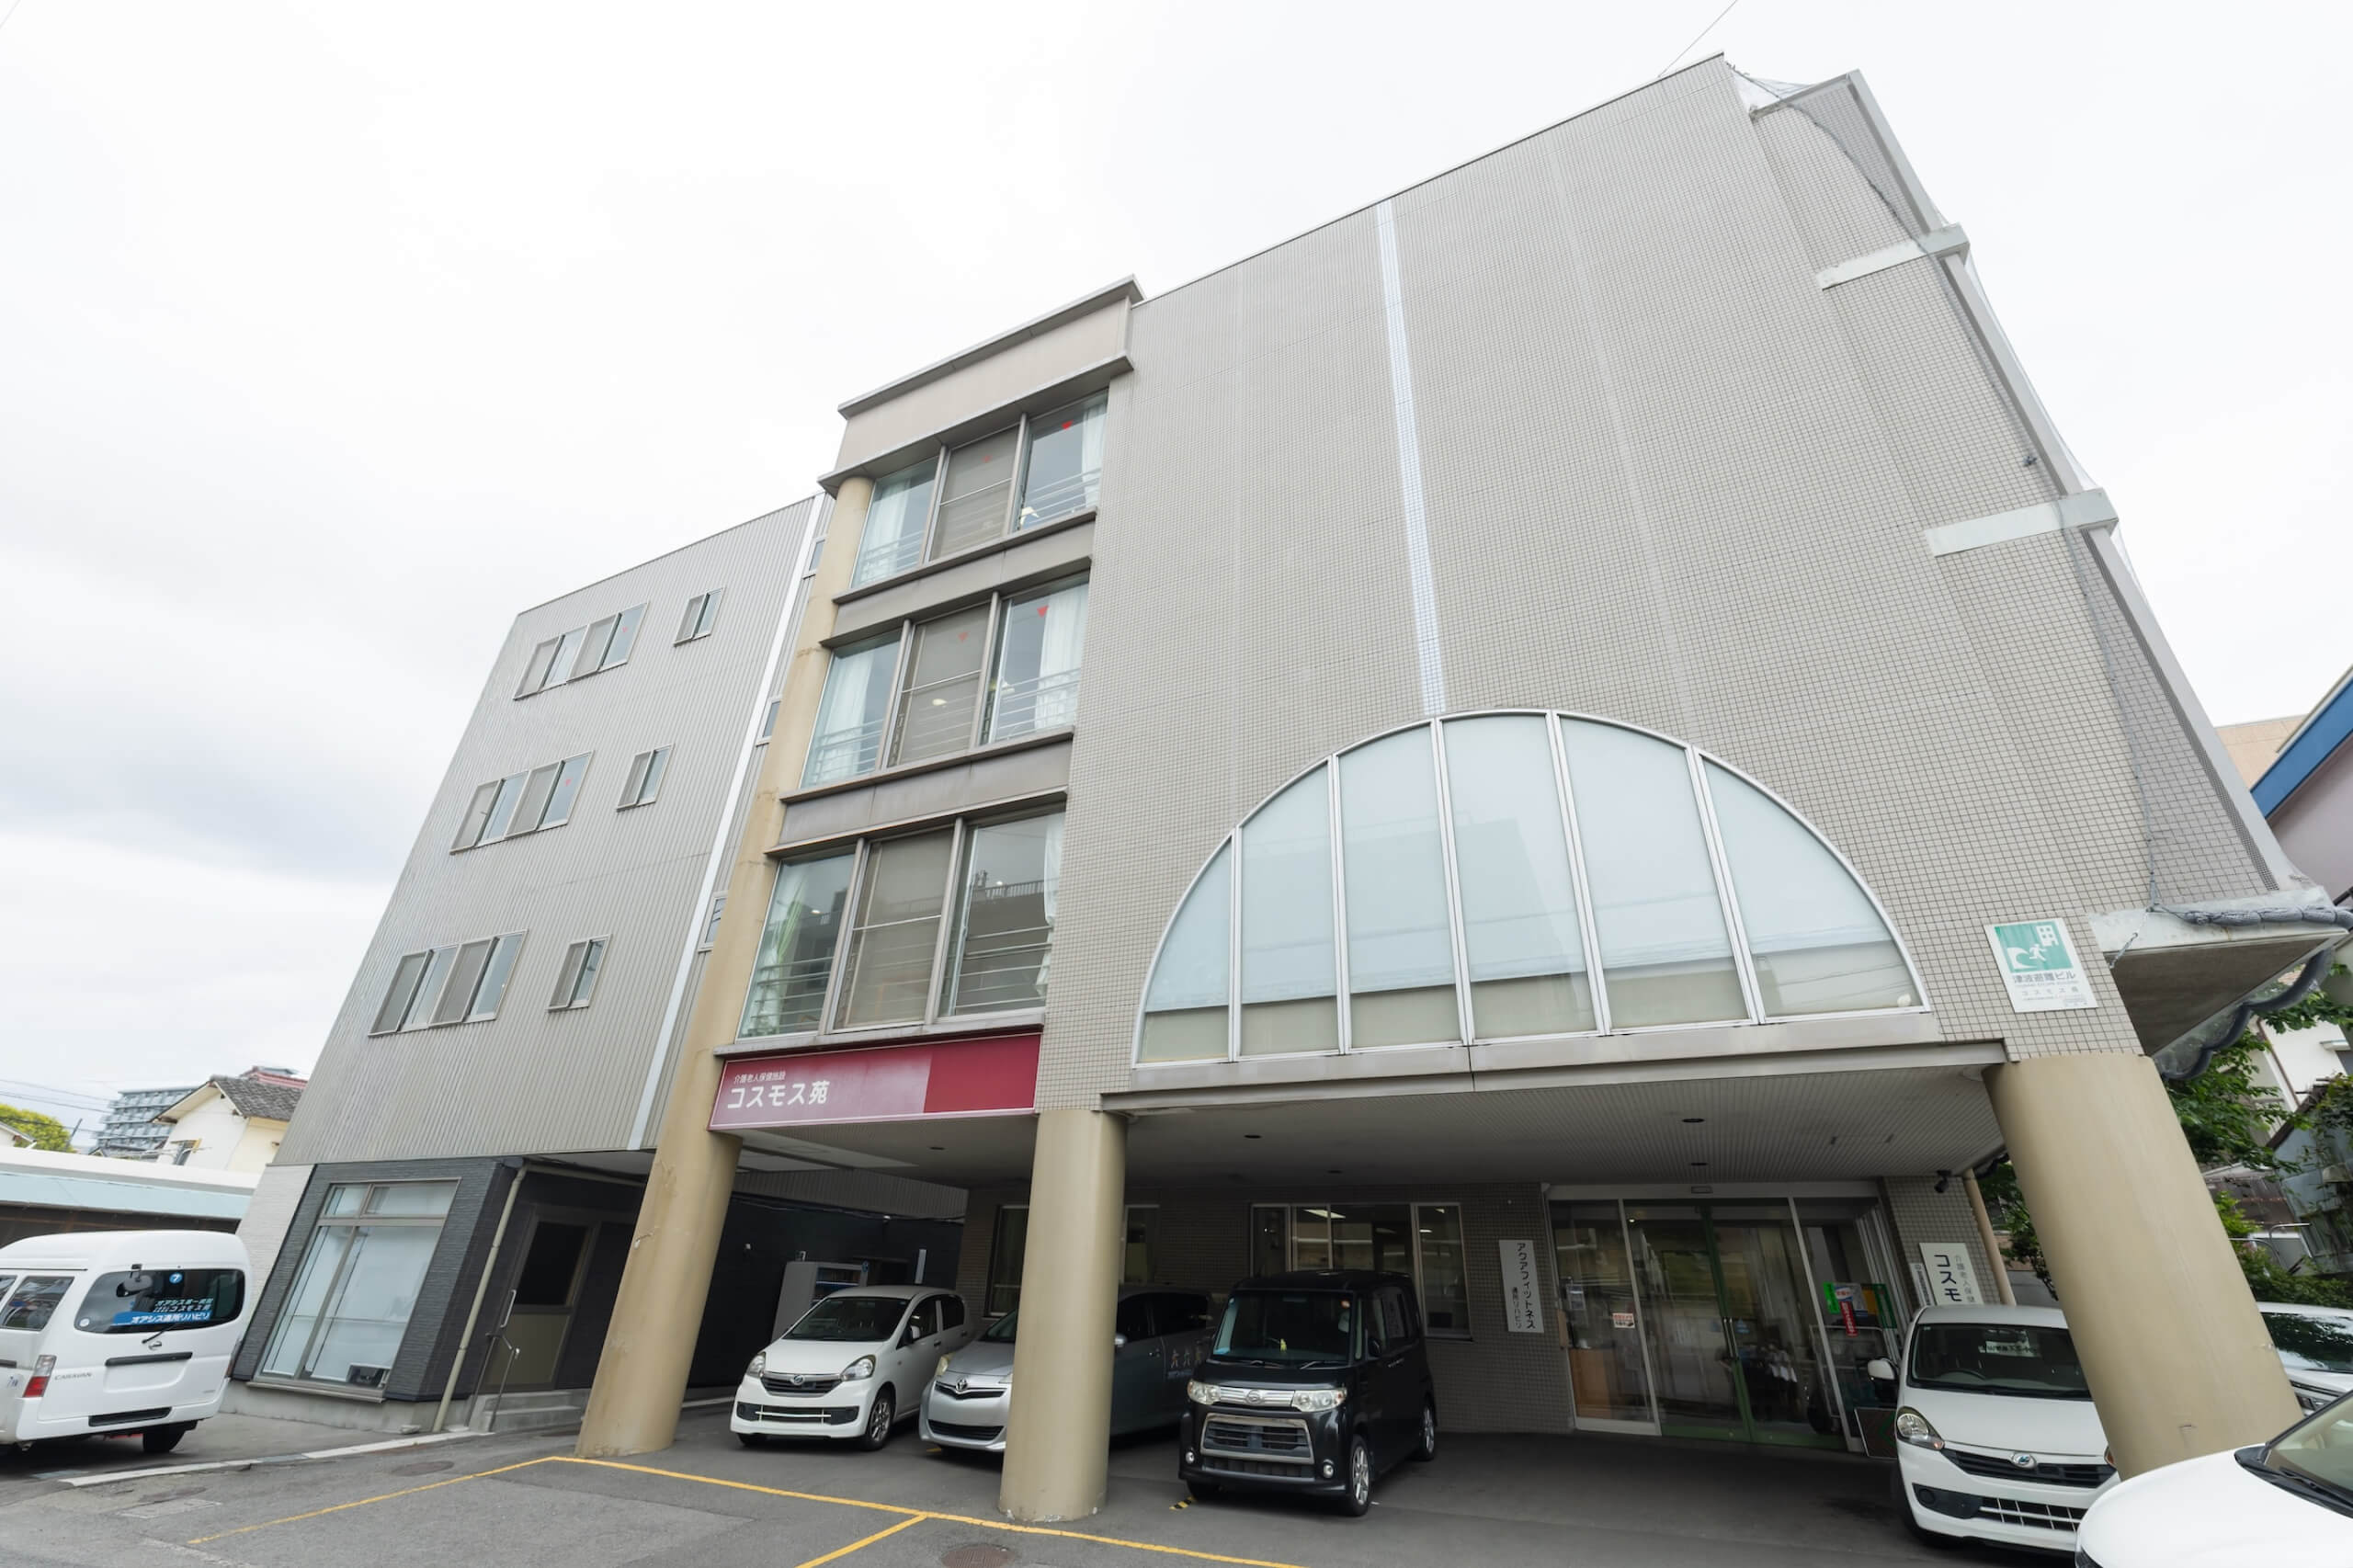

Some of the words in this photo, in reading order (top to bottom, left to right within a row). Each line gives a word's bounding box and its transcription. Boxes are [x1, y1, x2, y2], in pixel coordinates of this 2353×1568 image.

[734, 1072, 786, 1084] 介護老人保健施設
[727, 1081, 830, 1108] コスモス苑
[1517, 1243, 1536, 1329] アクアフィットネス
[131, 1312, 210, 1324] オアシス通所リハビリ
